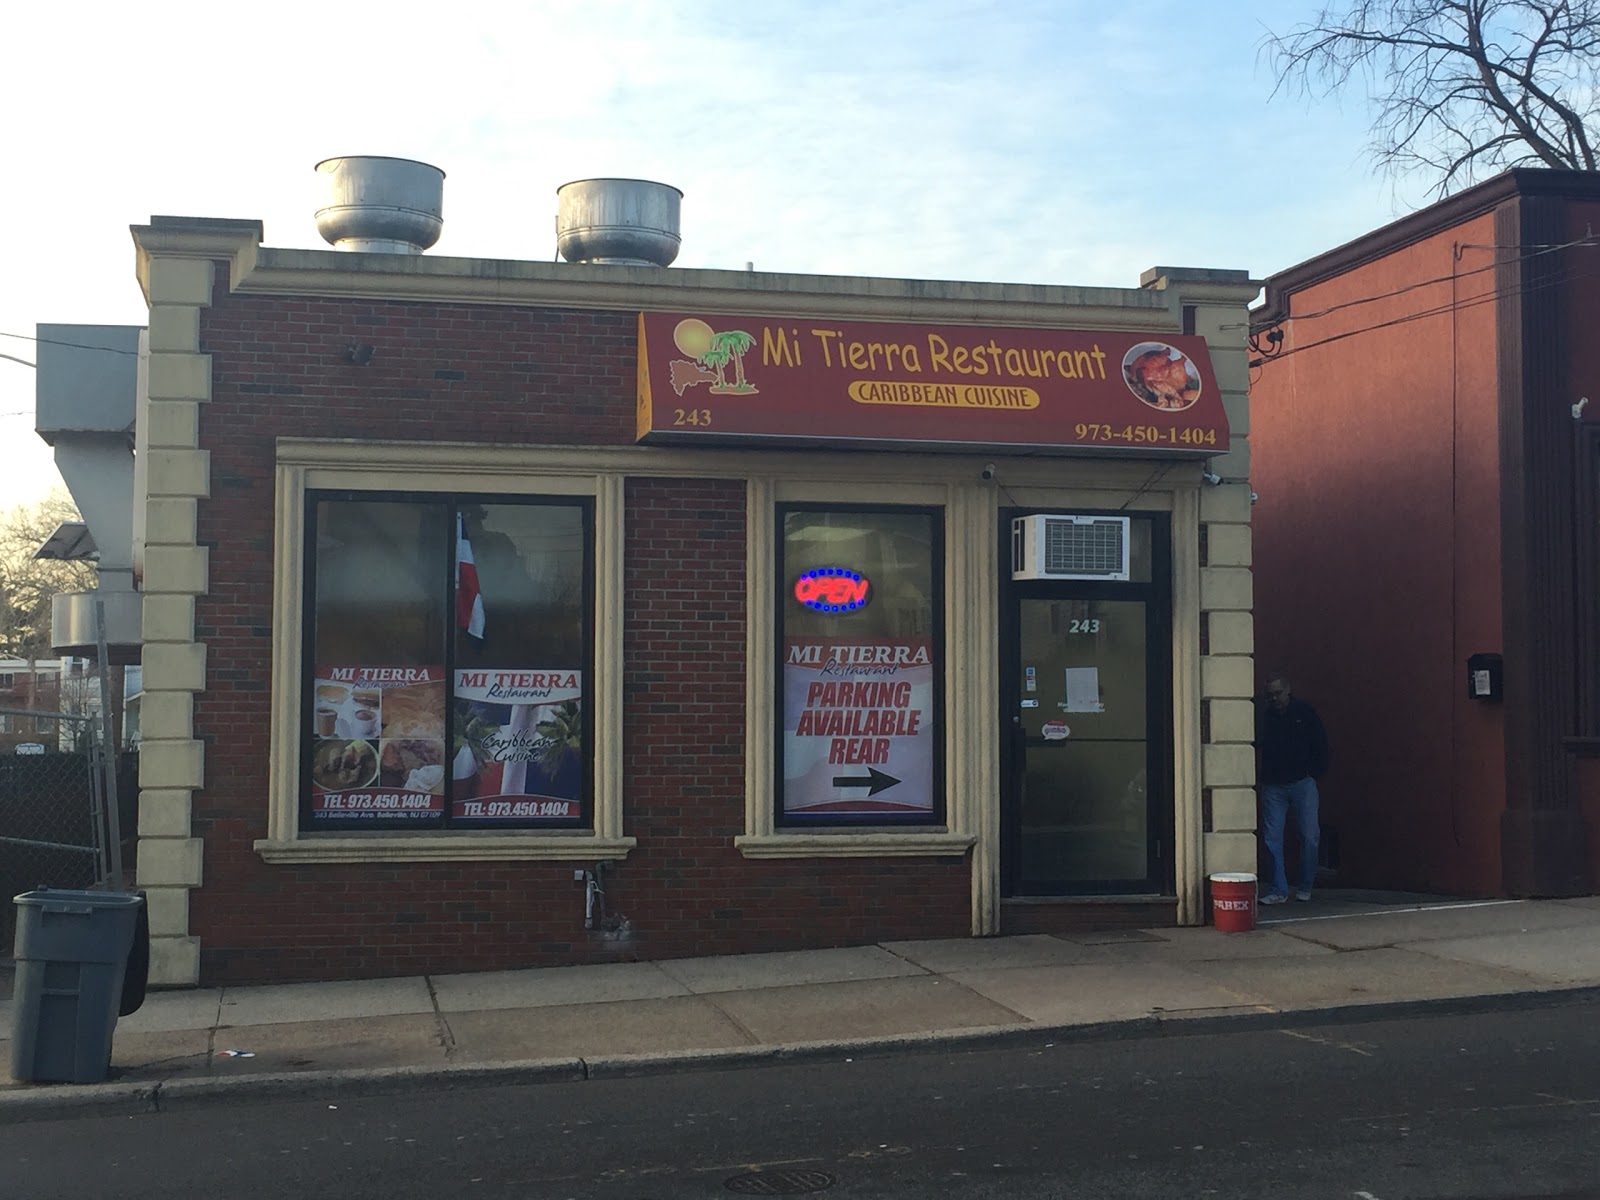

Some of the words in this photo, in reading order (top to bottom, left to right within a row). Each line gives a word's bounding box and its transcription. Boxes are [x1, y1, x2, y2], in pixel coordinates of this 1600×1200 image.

[762, 326, 801, 368] Mi
[811, 328, 922, 373] Tierra
[927, 333, 1106, 380] Restaurant
[858, 383, 958, 405] CARIBBEAN
[964, 387, 1032, 407] CUISINE
[673, 408, 712, 427] 243
[1074, 423, 1217, 445] 973-450-1404
[795, 577, 869, 604] OPEN
[1069, 619, 1100, 633] 243
[788, 645, 823, 664] MI
[830, 645, 930, 665] TIERRA
[330, 667, 356, 680] MI
[359, 668, 431, 681] TIERRA
[819, 657, 900, 677] Restaurant
[459, 672, 489, 688] MI
[494, 673, 579, 689] TIERRA
[486, 683, 551, 698] Restaurant
[806, 682, 911, 708] PARKING
[796, 710, 921, 737] AVAILABLE
[481, 730, 558, 750] Caribbean
[494, 746, 541, 763] Cuisine
[829, 738, 890, 765] REAR
[323, 794, 346, 809] TEL:
[347, 794, 432, 809] 973.450.1404
[463, 802, 486, 816] TEL:
[487, 802, 569, 816] 973.450.1404
